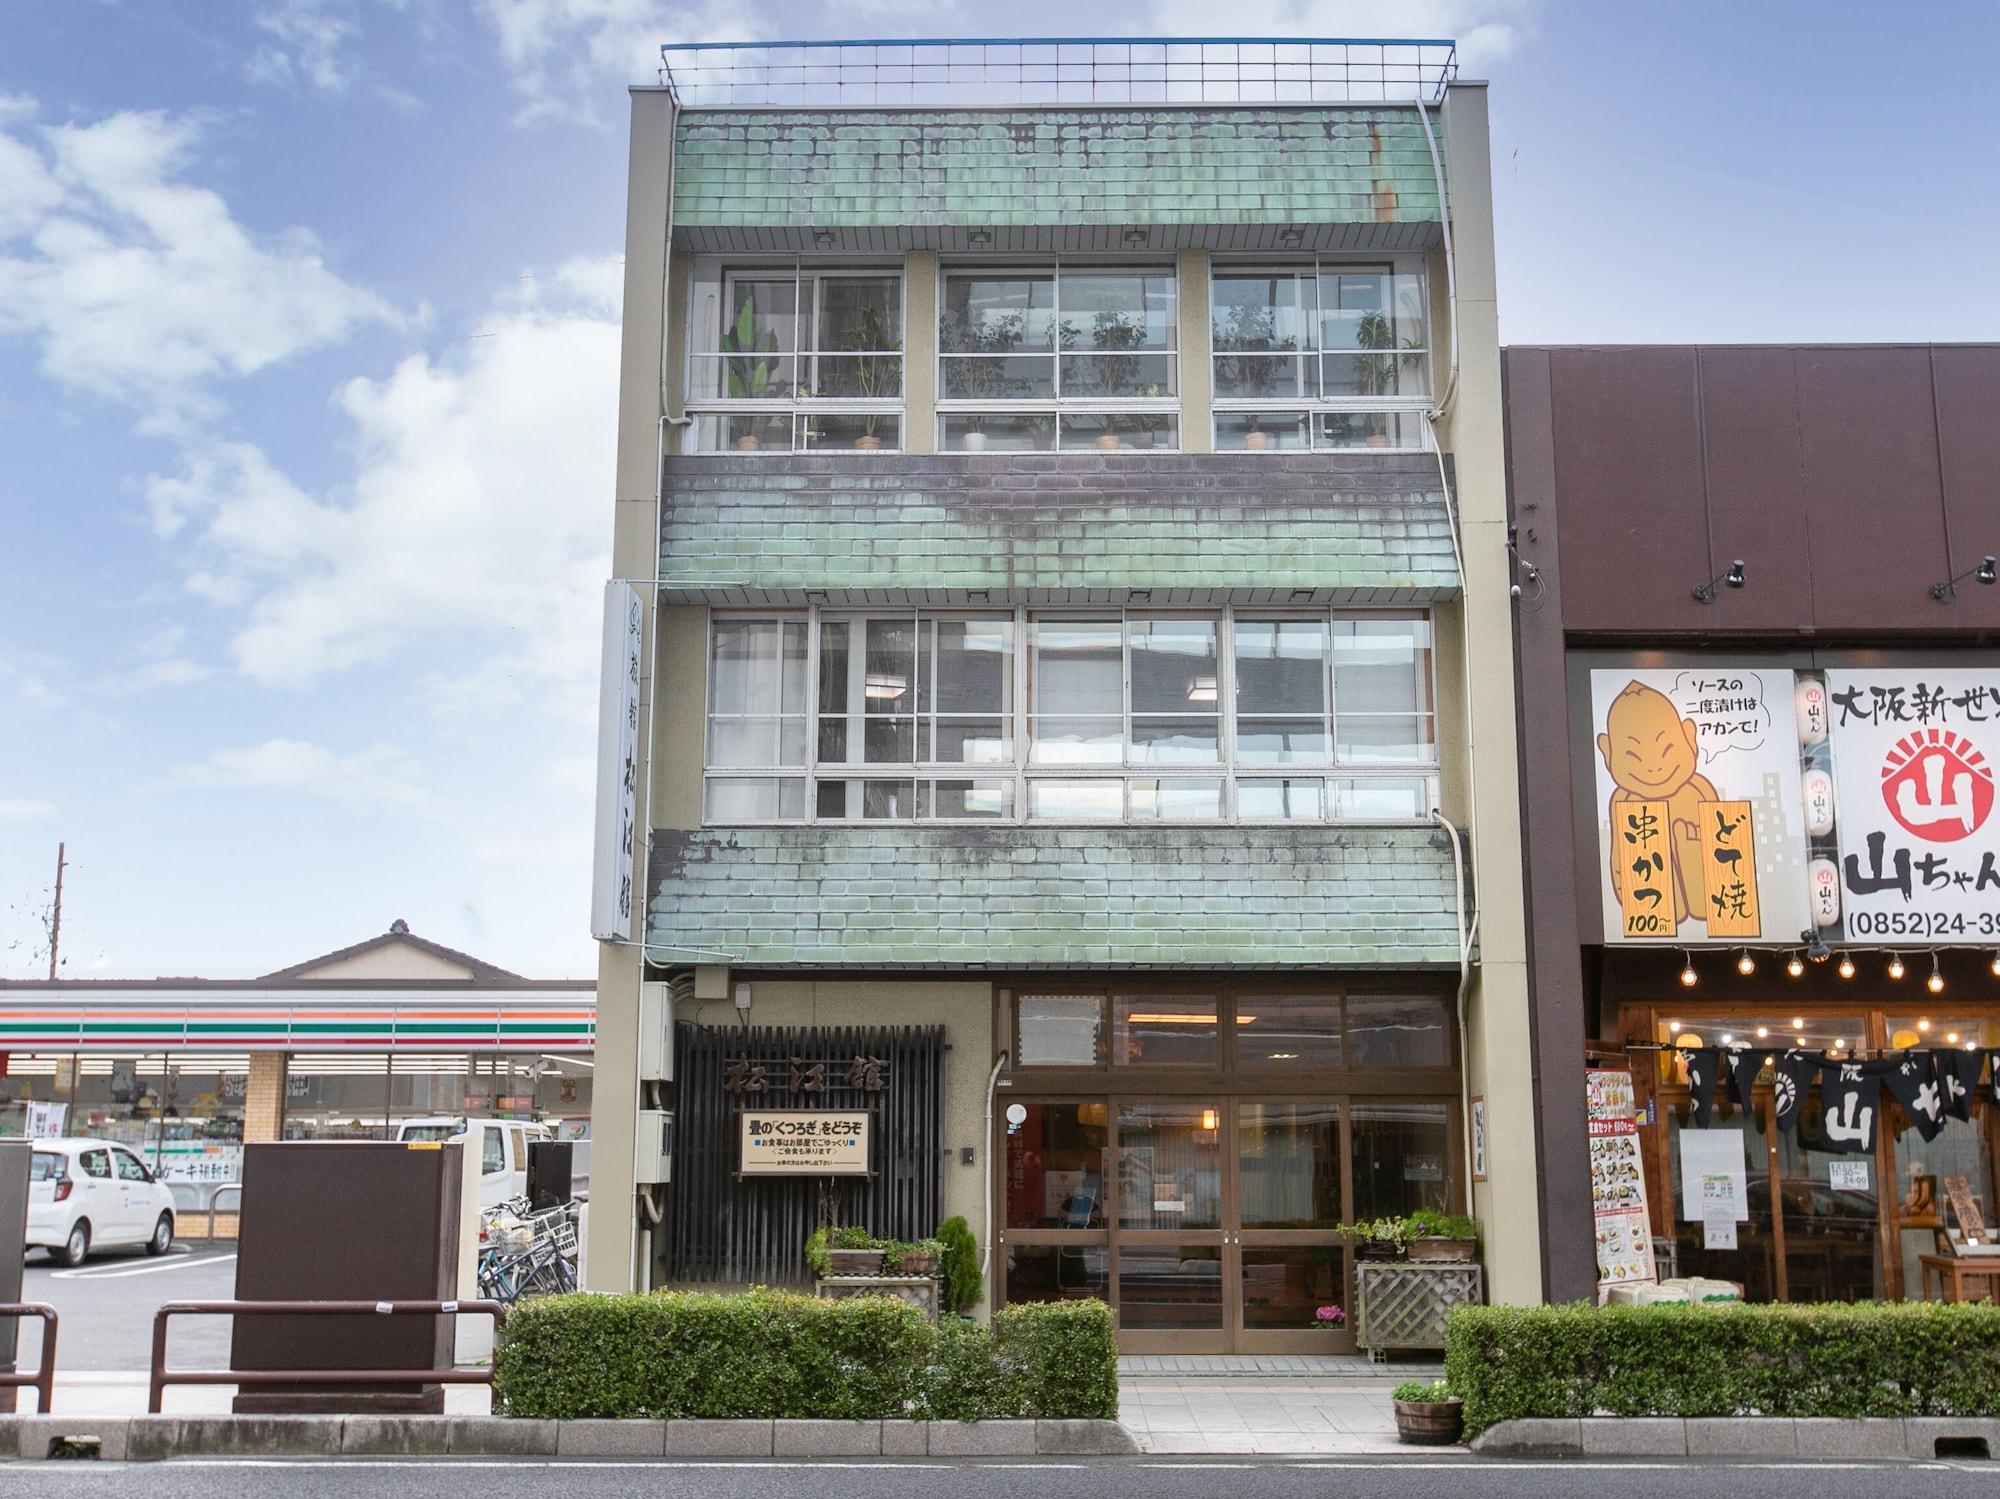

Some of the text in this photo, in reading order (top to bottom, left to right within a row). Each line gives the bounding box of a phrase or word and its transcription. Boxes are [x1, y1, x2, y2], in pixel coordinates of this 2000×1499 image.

[1691, 678, 1743, 693] ソースの
[1685, 697, 1758, 714] 二度漬けは
[1698, 719, 1759, 736] アカンで!
[1624, 805, 1664, 909] 串かつ
[1711, 810, 1753, 920] どて焼
[749, 1120, 862, 1136] 畳の「くつろぎ」をどうぞ
